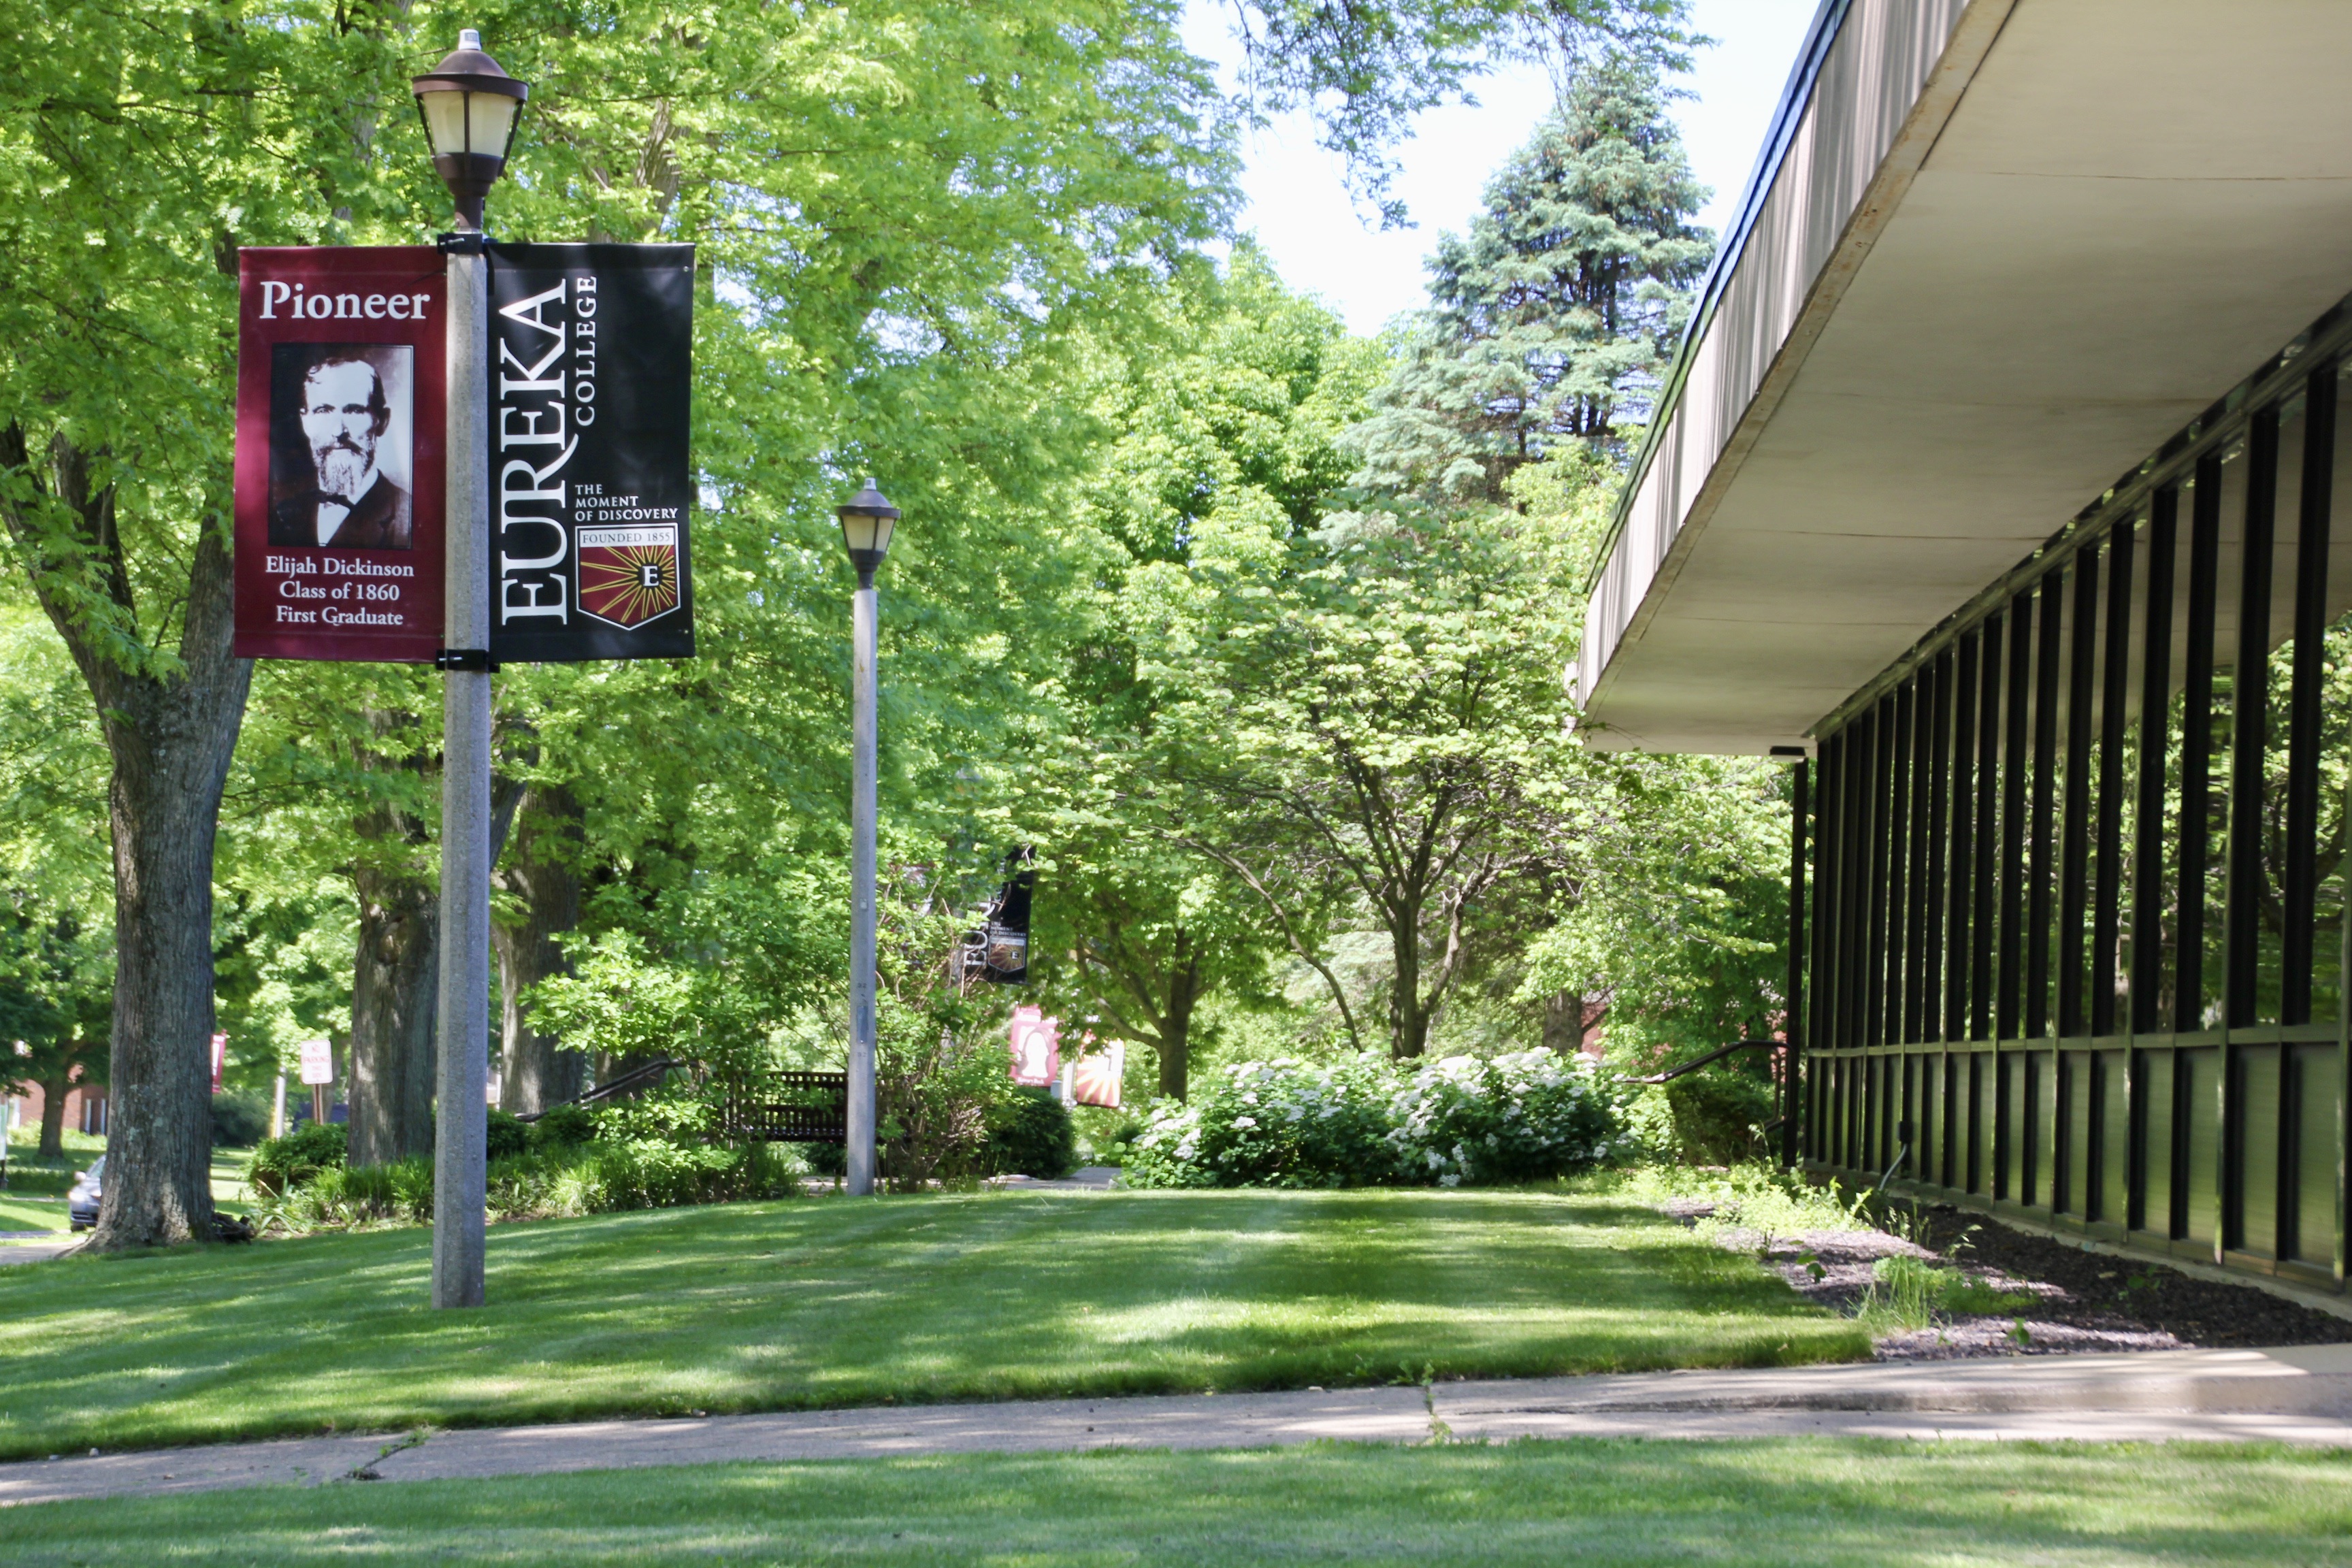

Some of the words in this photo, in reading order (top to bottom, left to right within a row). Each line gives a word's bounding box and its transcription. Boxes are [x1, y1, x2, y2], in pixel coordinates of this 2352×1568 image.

[259, 280, 431, 320] Pioneer
[576, 276, 597, 427] COLLEGE
[499, 278, 579, 625] EUREKA
[575, 484, 603, 495] THE
[575, 495, 639, 508] MOMENT
[575, 510, 593, 522] OF
[599, 508, 678, 521] DISCOVERY
[583, 533, 642, 544] FOUNDED
[647, 532, 670, 542] 1855
[265, 555, 318, 578] Elijah
[323, 557, 414, 577] Dickinson
[642, 566, 659, 587] E
[279, 581, 327, 599] Class
[331, 582, 353, 600] of
[356, 584, 400, 601] 1860
[276, 605, 317, 623] First
[321, 606, 404, 627] Graduate
